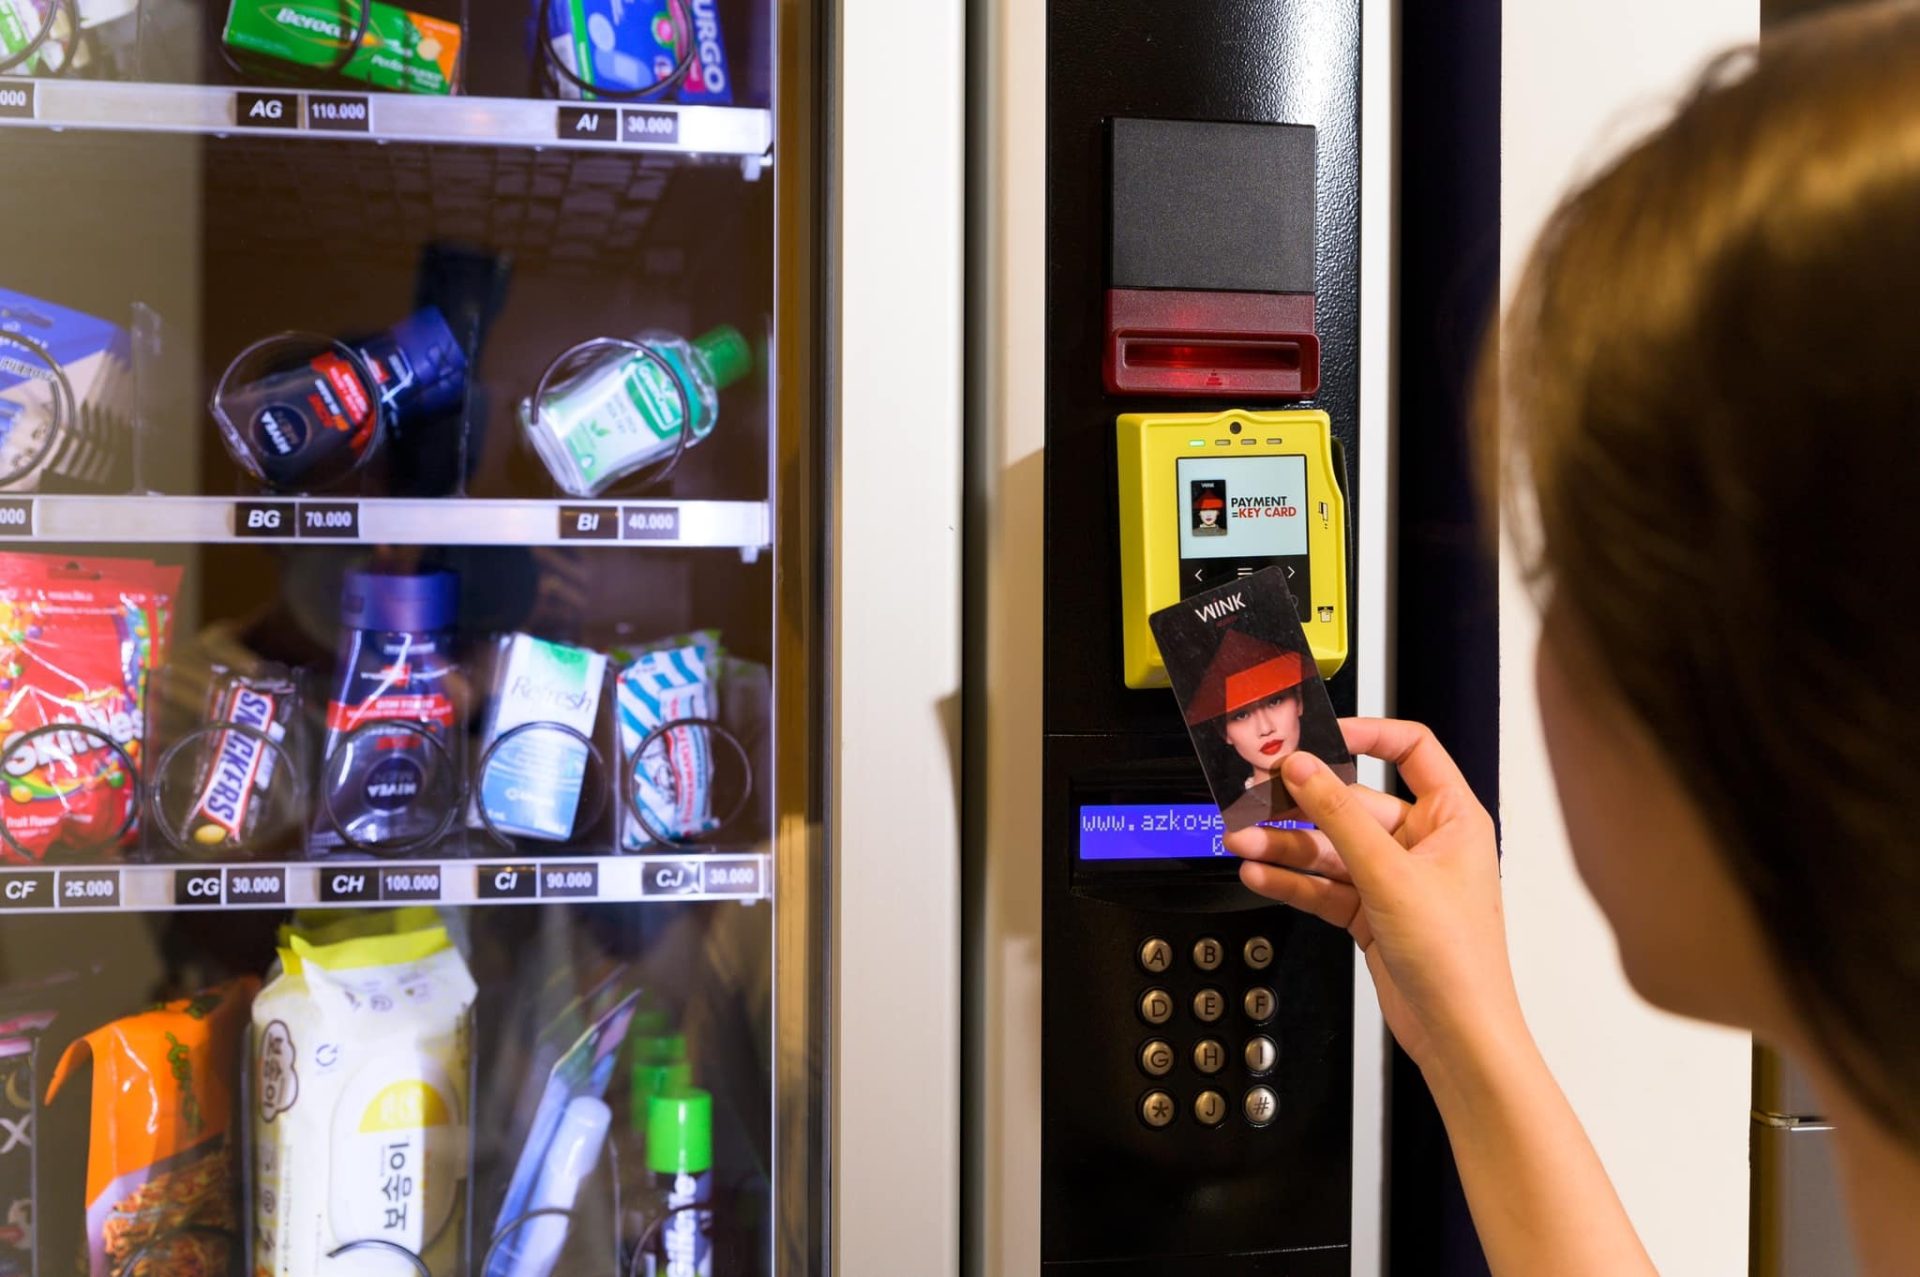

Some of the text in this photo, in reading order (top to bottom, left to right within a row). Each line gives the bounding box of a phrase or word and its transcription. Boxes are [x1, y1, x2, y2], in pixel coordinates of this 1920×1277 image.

[250, 100, 366, 120] AG 110.000
[576, 114, 674, 134] AI 30.000
[1231, 496, 1287, 508] PAYMENT
[1264, 506, 1297, 518] CARD
[248, 510, 353, 528] BG 70.000
[576, 514, 674, 531] BI 40.000
[1194, 592, 1246, 623] WINK
[367, 783, 417, 799] NIVEA
[187, 876, 280, 897] CG 30.000
[331, 874, 440, 894] CH 100.000
[494, 871, 592, 890] CI 90.000
[655, 867, 754, 887] CJ 30.000
[5, 880, 115, 900] CF 25.000
[1148, 944, 1269, 967] A B C
[1151, 995, 1266, 1018] D E F
[1150, 1050, 1170, 1068] G
[1203, 1047, 1218, 1066] H
[1205, 1096, 1216, 1117] J
[381, 1141, 413, 1231] 보송이
